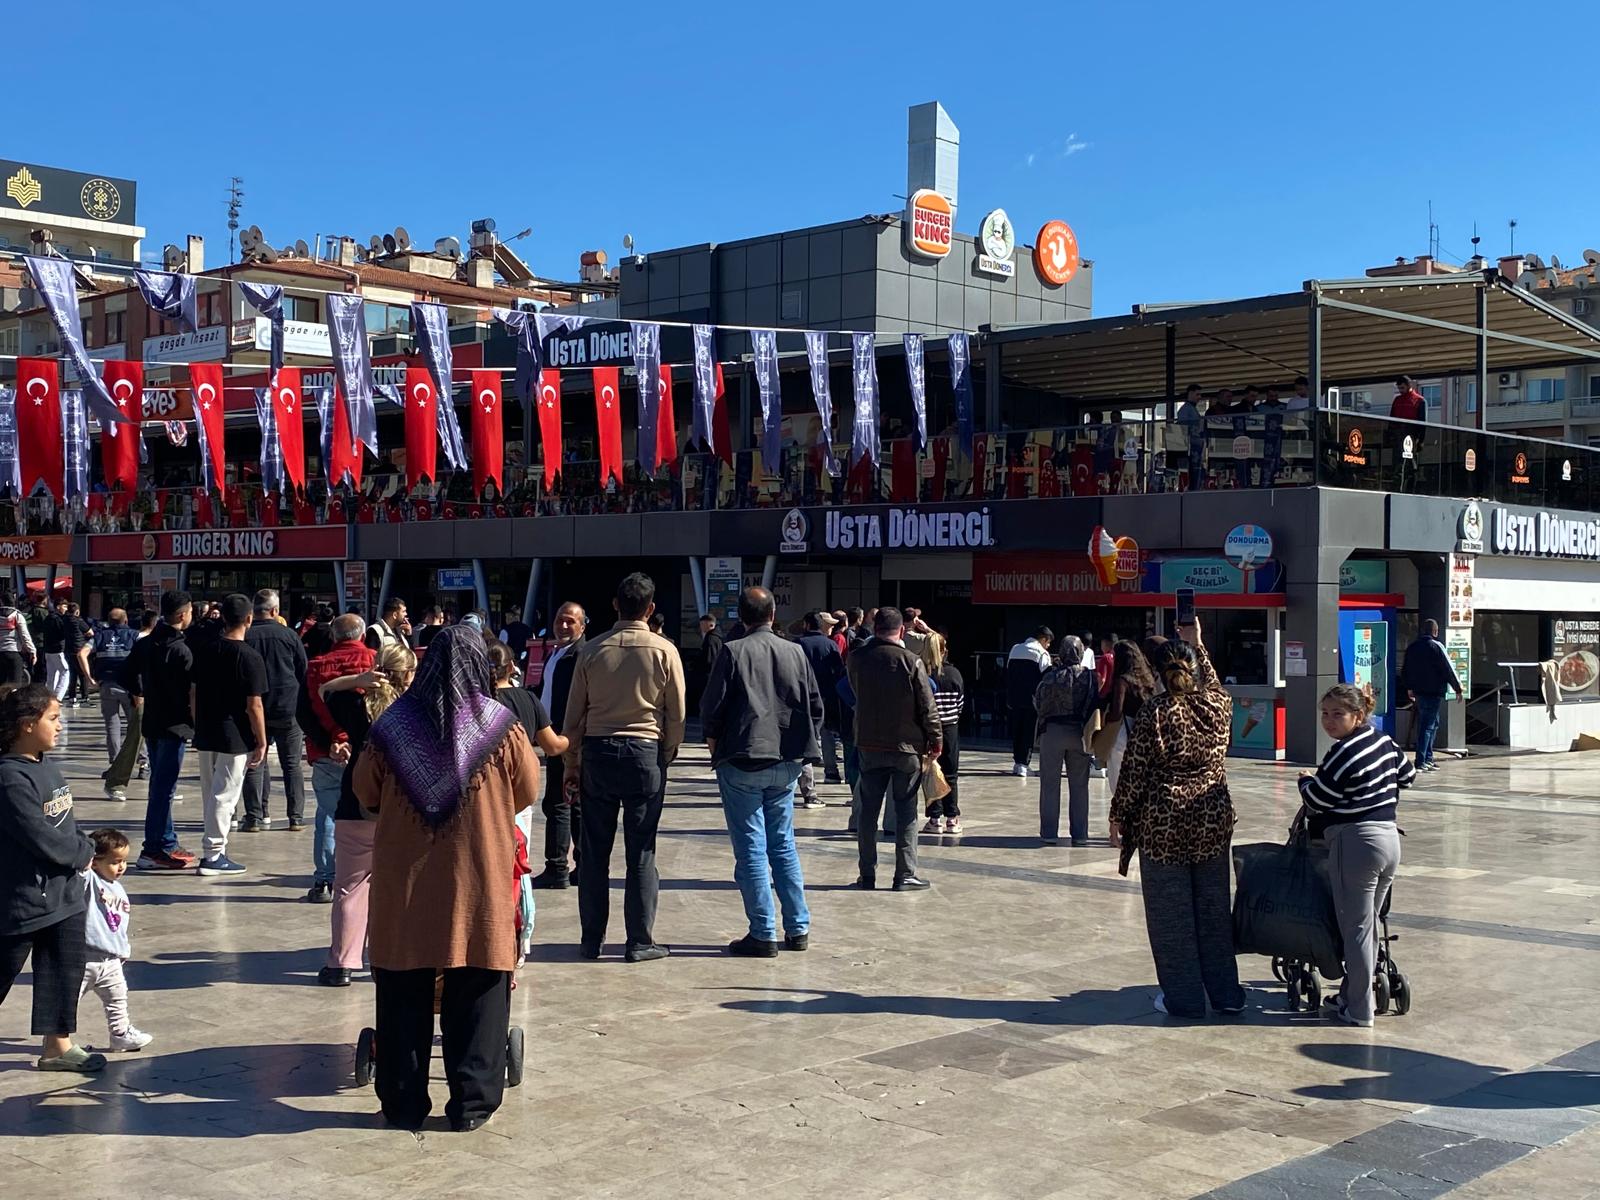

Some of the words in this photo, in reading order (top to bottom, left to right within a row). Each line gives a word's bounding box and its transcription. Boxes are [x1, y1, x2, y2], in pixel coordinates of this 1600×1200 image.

[914, 208, 951, 228] BURGER
[914, 221, 951, 245] KING
[549, 337, 587, 366] USTA
[825, 511, 882, 549] USTA
[888, 506, 991, 548] DÖNERCİ
[1496, 507, 1536, 552] USTA
[172, 532, 231, 556] BURGER
[234, 531, 274, 555] KING
[1228, 536, 1269, 545] DONDURMA
[453, 578, 464, 586] WC
[985, 570, 1053, 592] TÜRKİYE'NİN
[1055, 573, 1069, 592] EN
[1184, 575, 1230, 588] SERİNLİK
[1193, 567, 1210, 577] SEÇ
[1565, 620, 1579, 631] USTA
